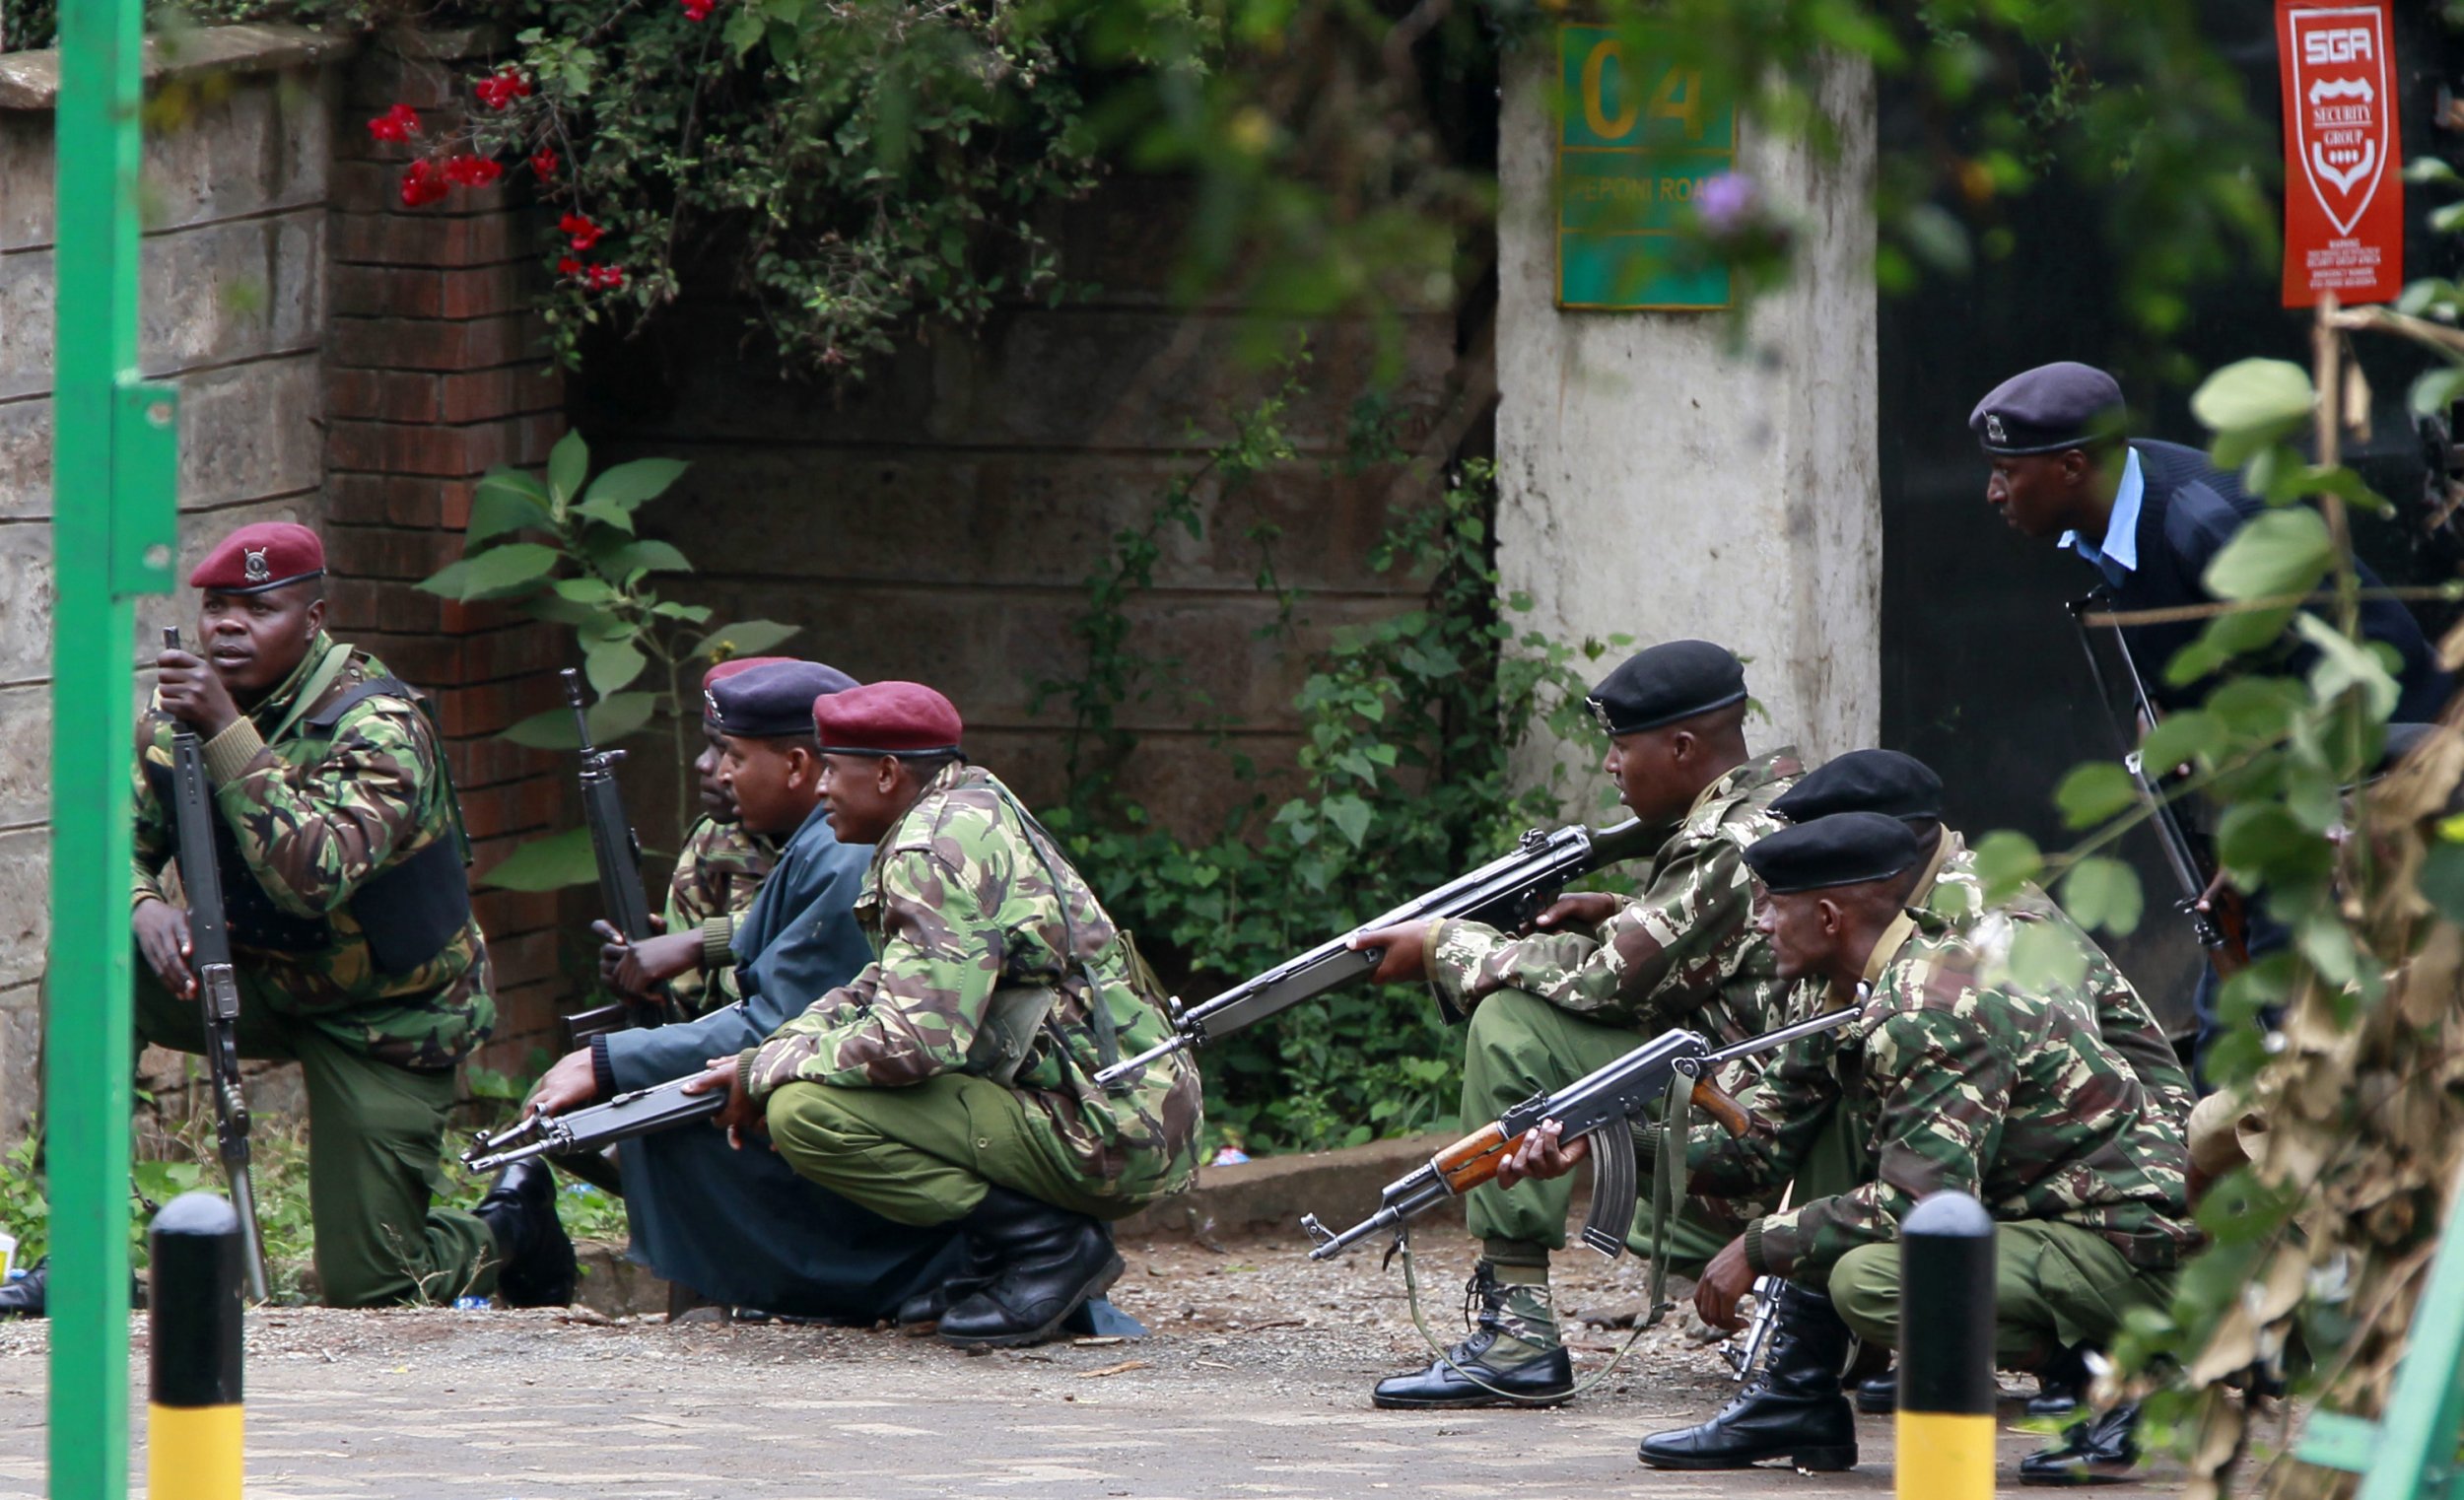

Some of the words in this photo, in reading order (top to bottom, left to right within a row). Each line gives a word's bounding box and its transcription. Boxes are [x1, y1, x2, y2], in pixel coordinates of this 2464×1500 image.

[2304, 28, 2372, 64] SGA
[2314, 104, 2372, 122] SECURITY
[2323, 129, 2363, 147] GROUP
